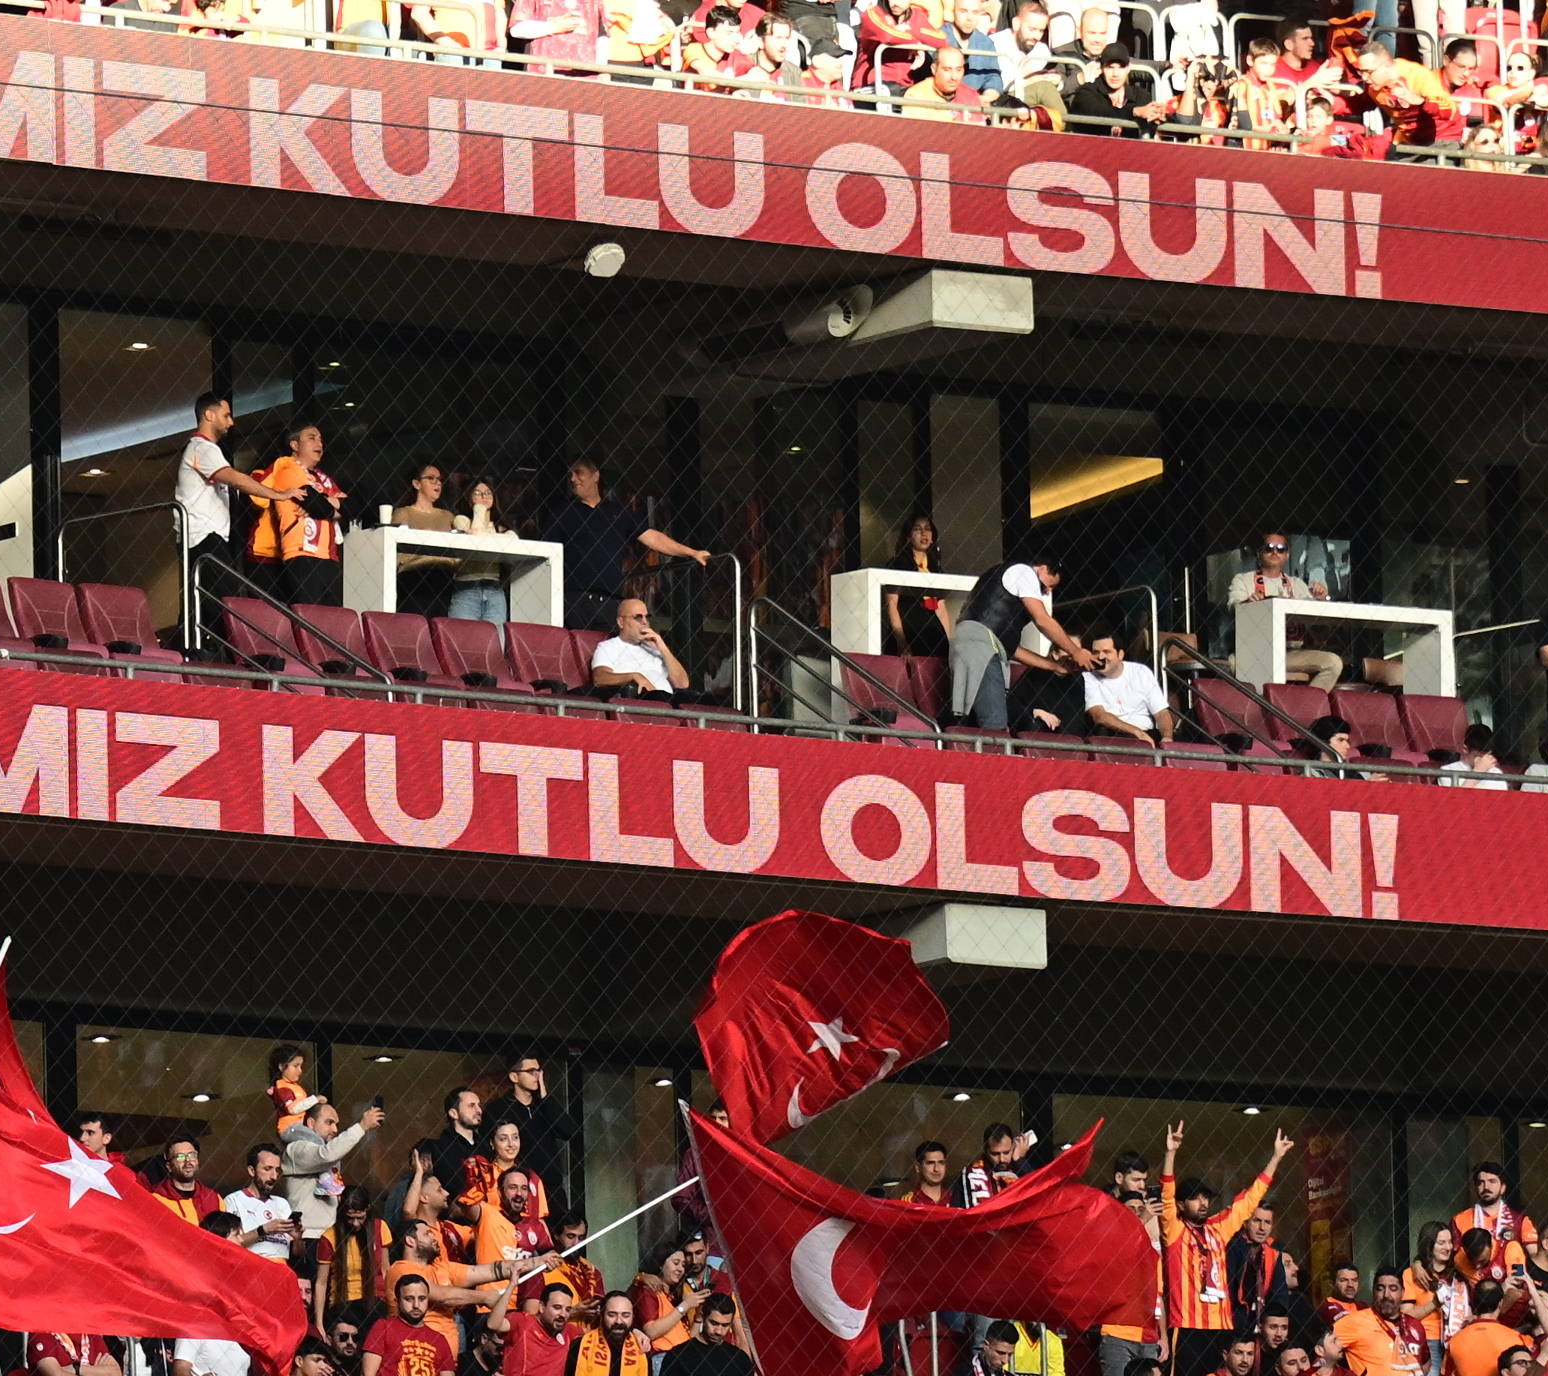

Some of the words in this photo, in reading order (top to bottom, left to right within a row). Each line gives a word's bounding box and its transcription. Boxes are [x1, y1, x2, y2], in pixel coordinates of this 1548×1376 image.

[247, 77, 765, 239] KUTLU
[804, 141, 1383, 299] OLSUN!
[261, 726, 787, 872] KUTLU
[822, 779, 1405, 930] OLSUN!
